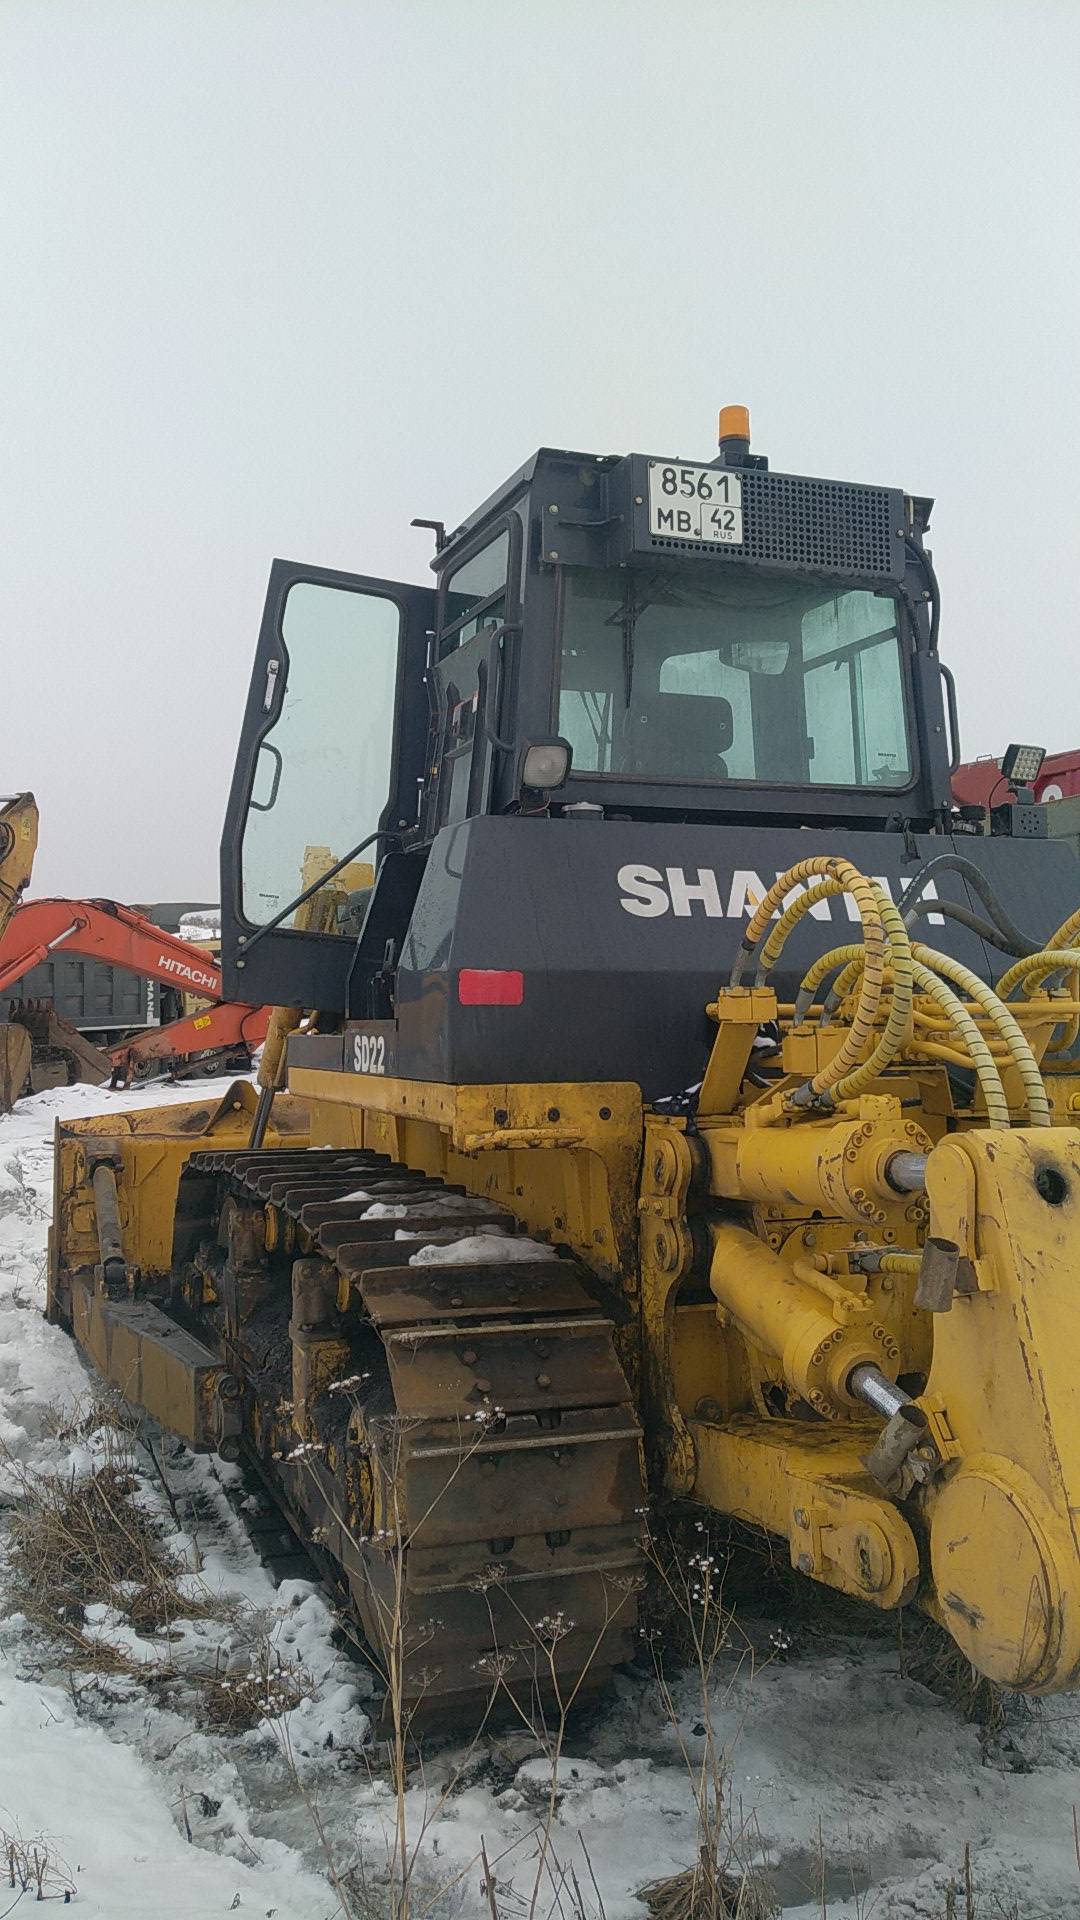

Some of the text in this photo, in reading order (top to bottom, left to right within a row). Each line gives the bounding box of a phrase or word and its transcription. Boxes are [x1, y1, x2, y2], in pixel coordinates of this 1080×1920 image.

[662, 468, 730, 503] 8561
[710, 508, 736, 531] 42
[713, 530, 733, 540] RUS
[158, 955, 217, 990] HITACHI
[146, 980, 154, 1011] MAN
[353, 1035, 385, 1074] SD22
